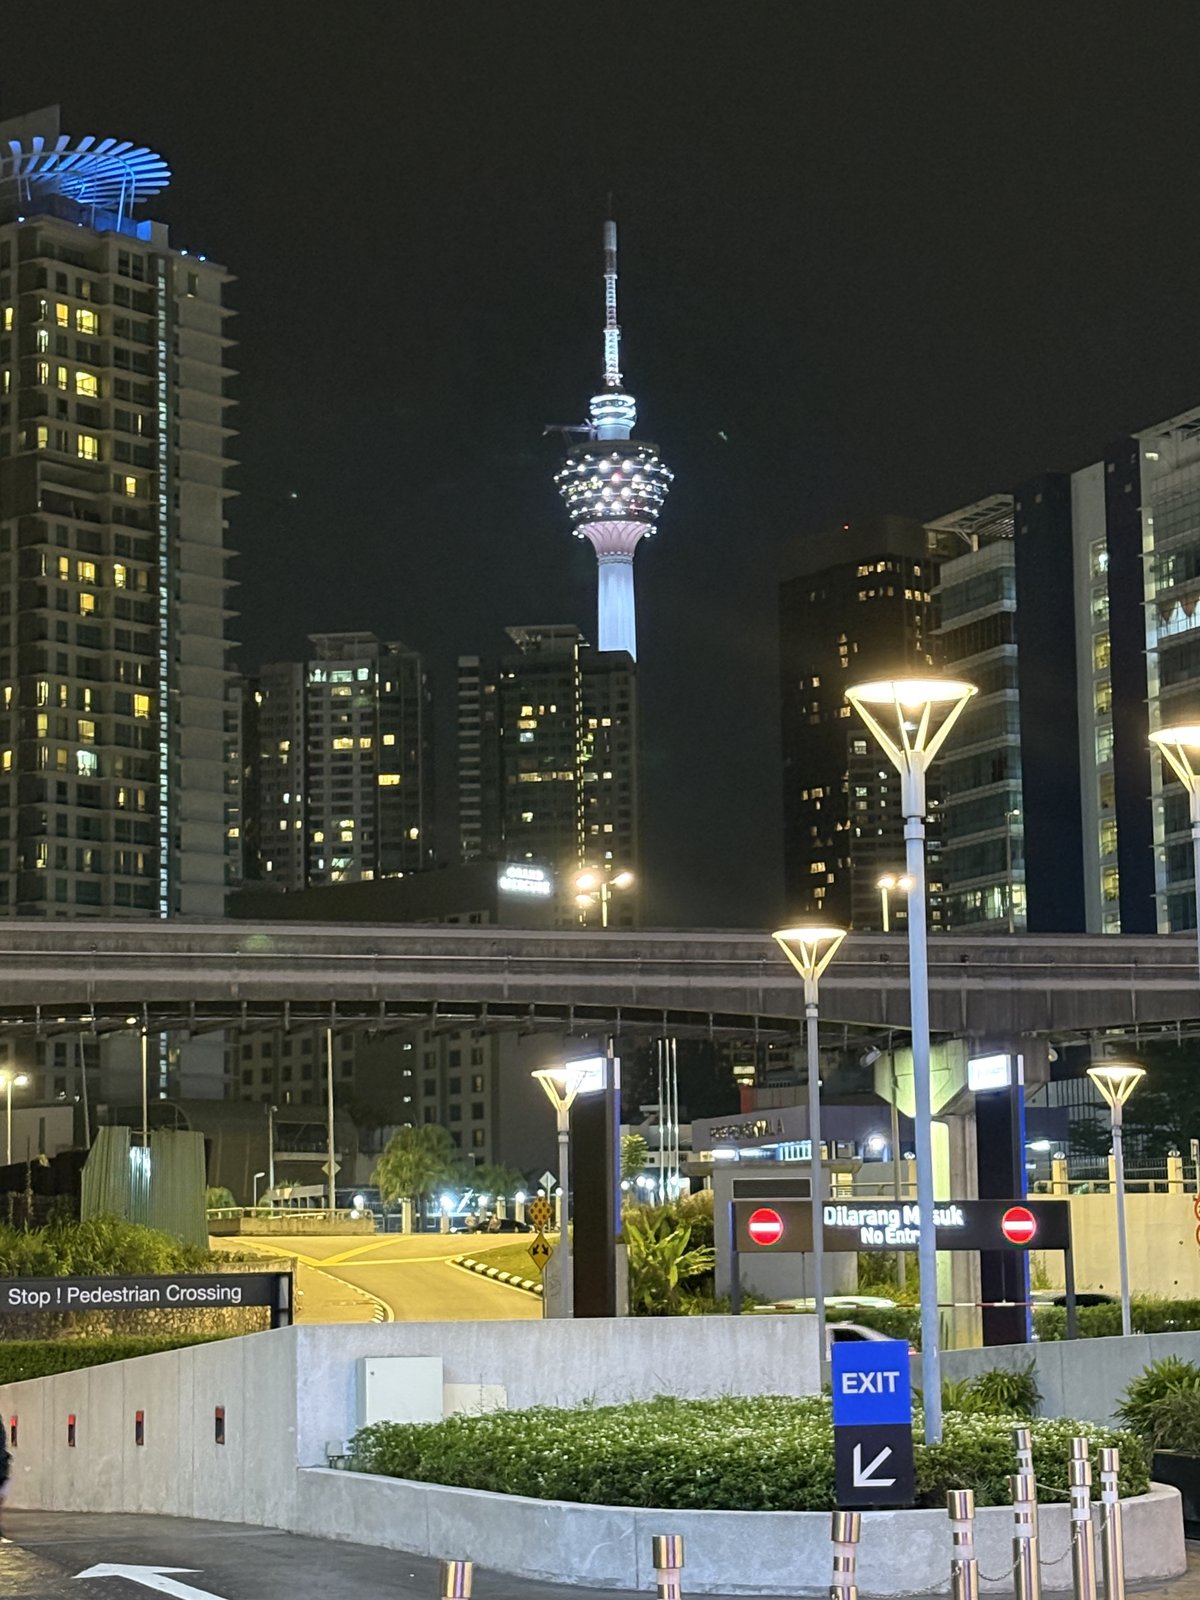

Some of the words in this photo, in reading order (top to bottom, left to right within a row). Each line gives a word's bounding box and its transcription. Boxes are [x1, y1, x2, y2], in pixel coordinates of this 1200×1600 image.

[823, 1206, 901, 1229] Dilarang
[902, 1205, 965, 1226] Msuk
[860, 1227, 884, 1245] No
[885, 1228, 921, 1245] Entr
[8, 1287, 51, 1308] Stop
[67, 1286, 160, 1304] Pedestrian
[166, 1284, 242, 1304] Crossing
[842, 1371, 900, 1394] EXIT
